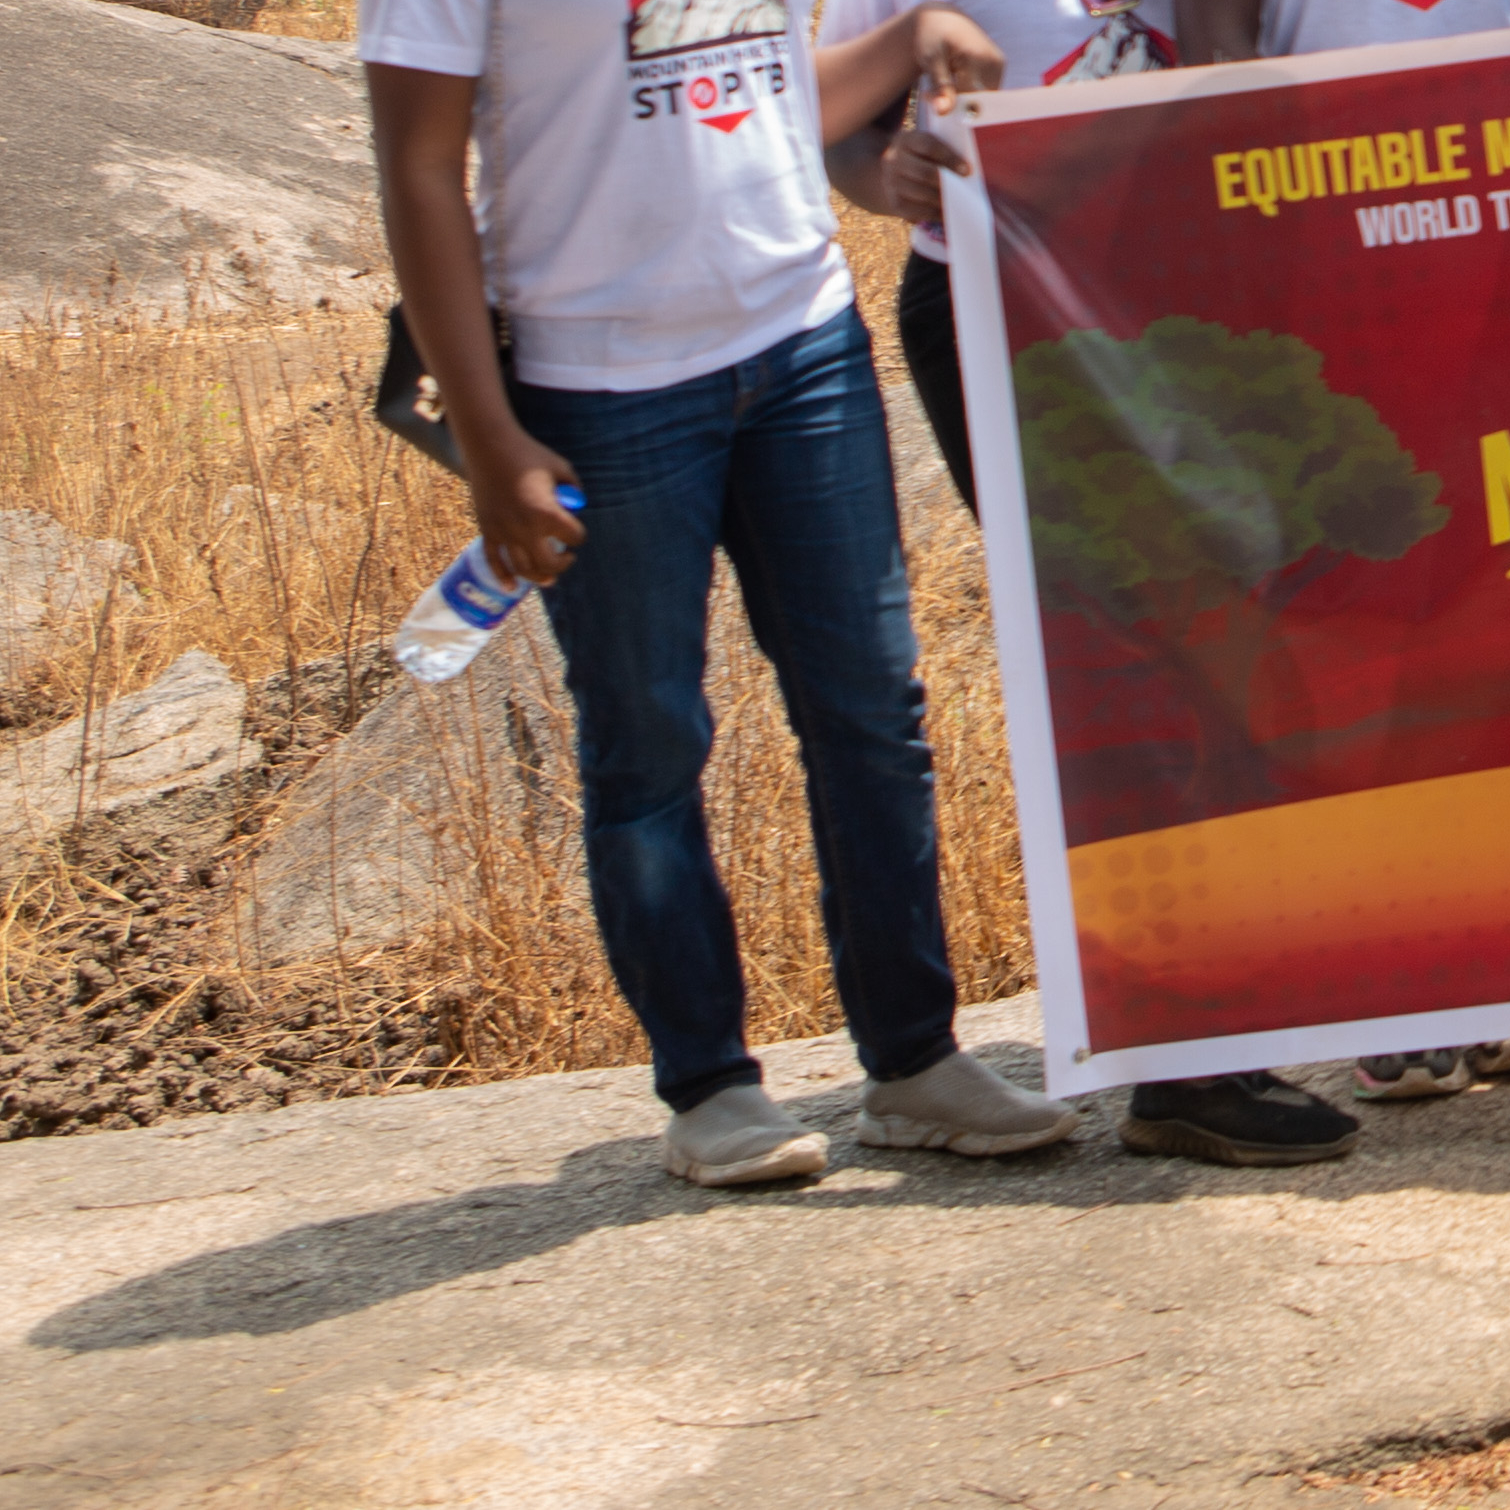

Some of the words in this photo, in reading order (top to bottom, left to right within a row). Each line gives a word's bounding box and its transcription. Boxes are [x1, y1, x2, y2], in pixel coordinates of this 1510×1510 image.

[634, 72, 740, 119] STOP
[1213, 124, 1470, 216] EQUITABLE
[1356, 195, 1482, 248] WORLD
